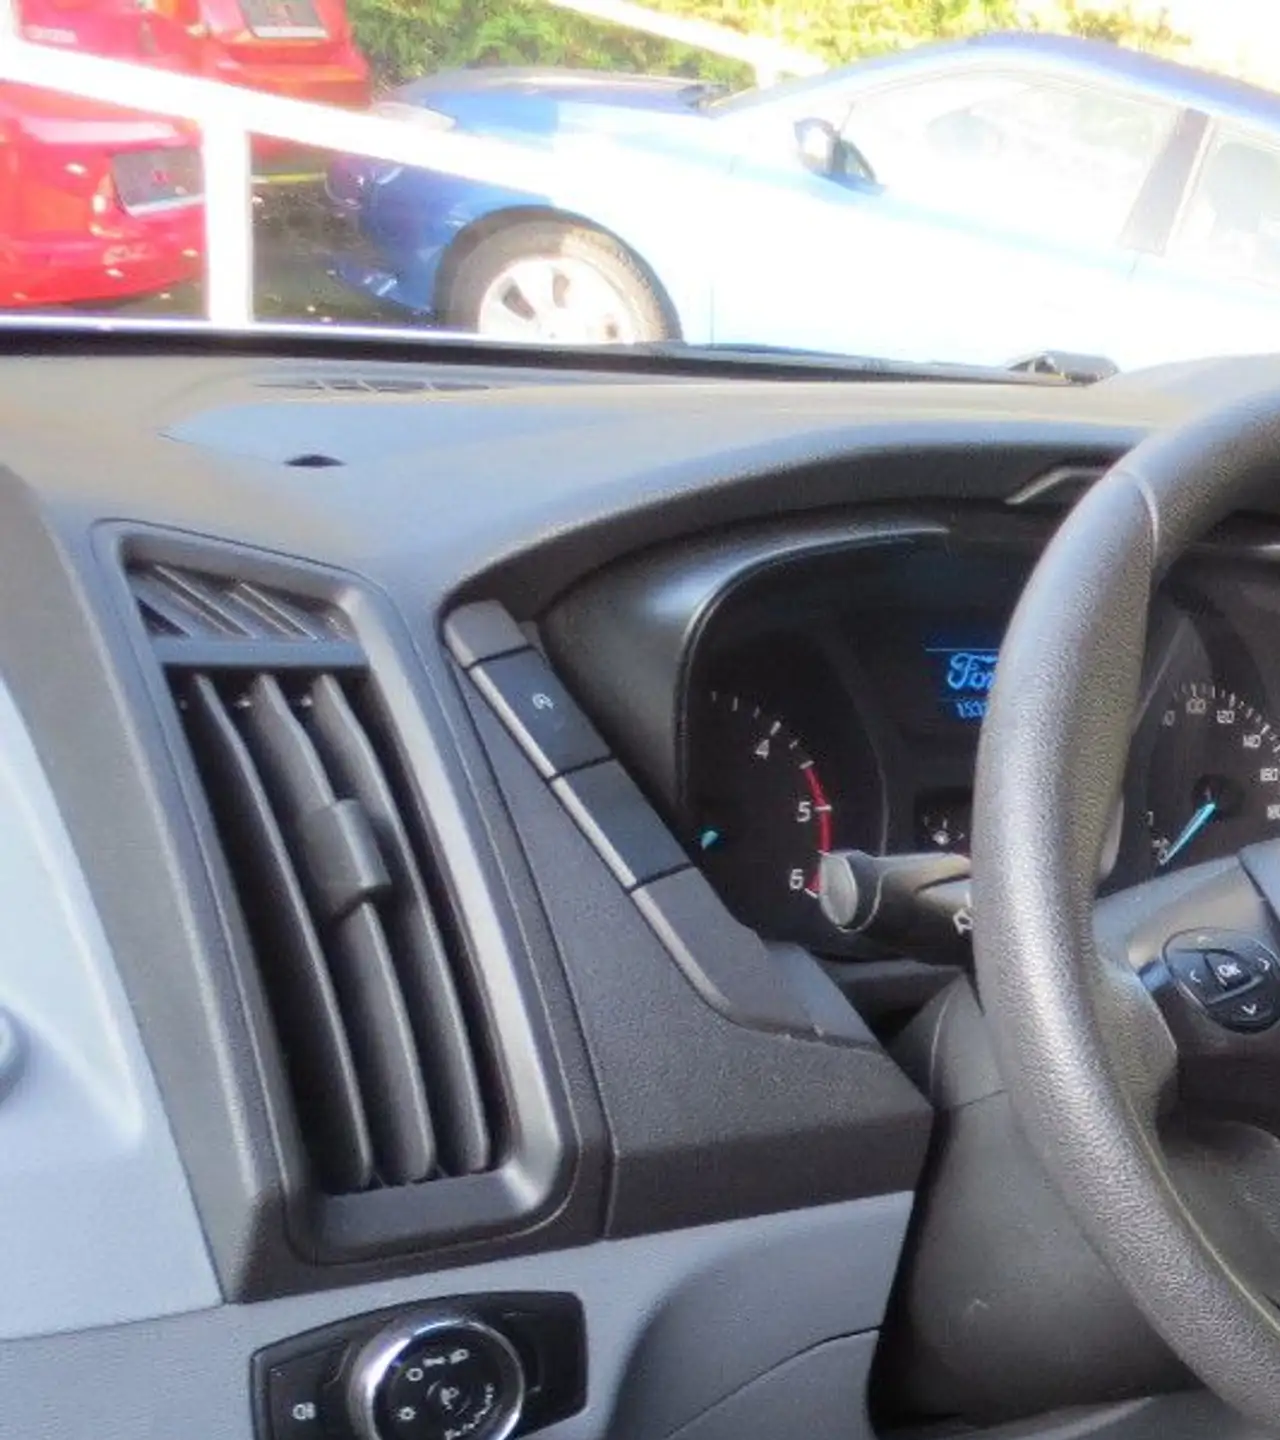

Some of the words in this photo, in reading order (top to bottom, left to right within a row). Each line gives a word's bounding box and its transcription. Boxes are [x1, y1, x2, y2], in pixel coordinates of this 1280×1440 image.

[755, 739, 770, 760] 4
[796, 801, 812, 823] 5
[789, 868, 804, 890] 6
[1217, 963, 1242, 978] OK
